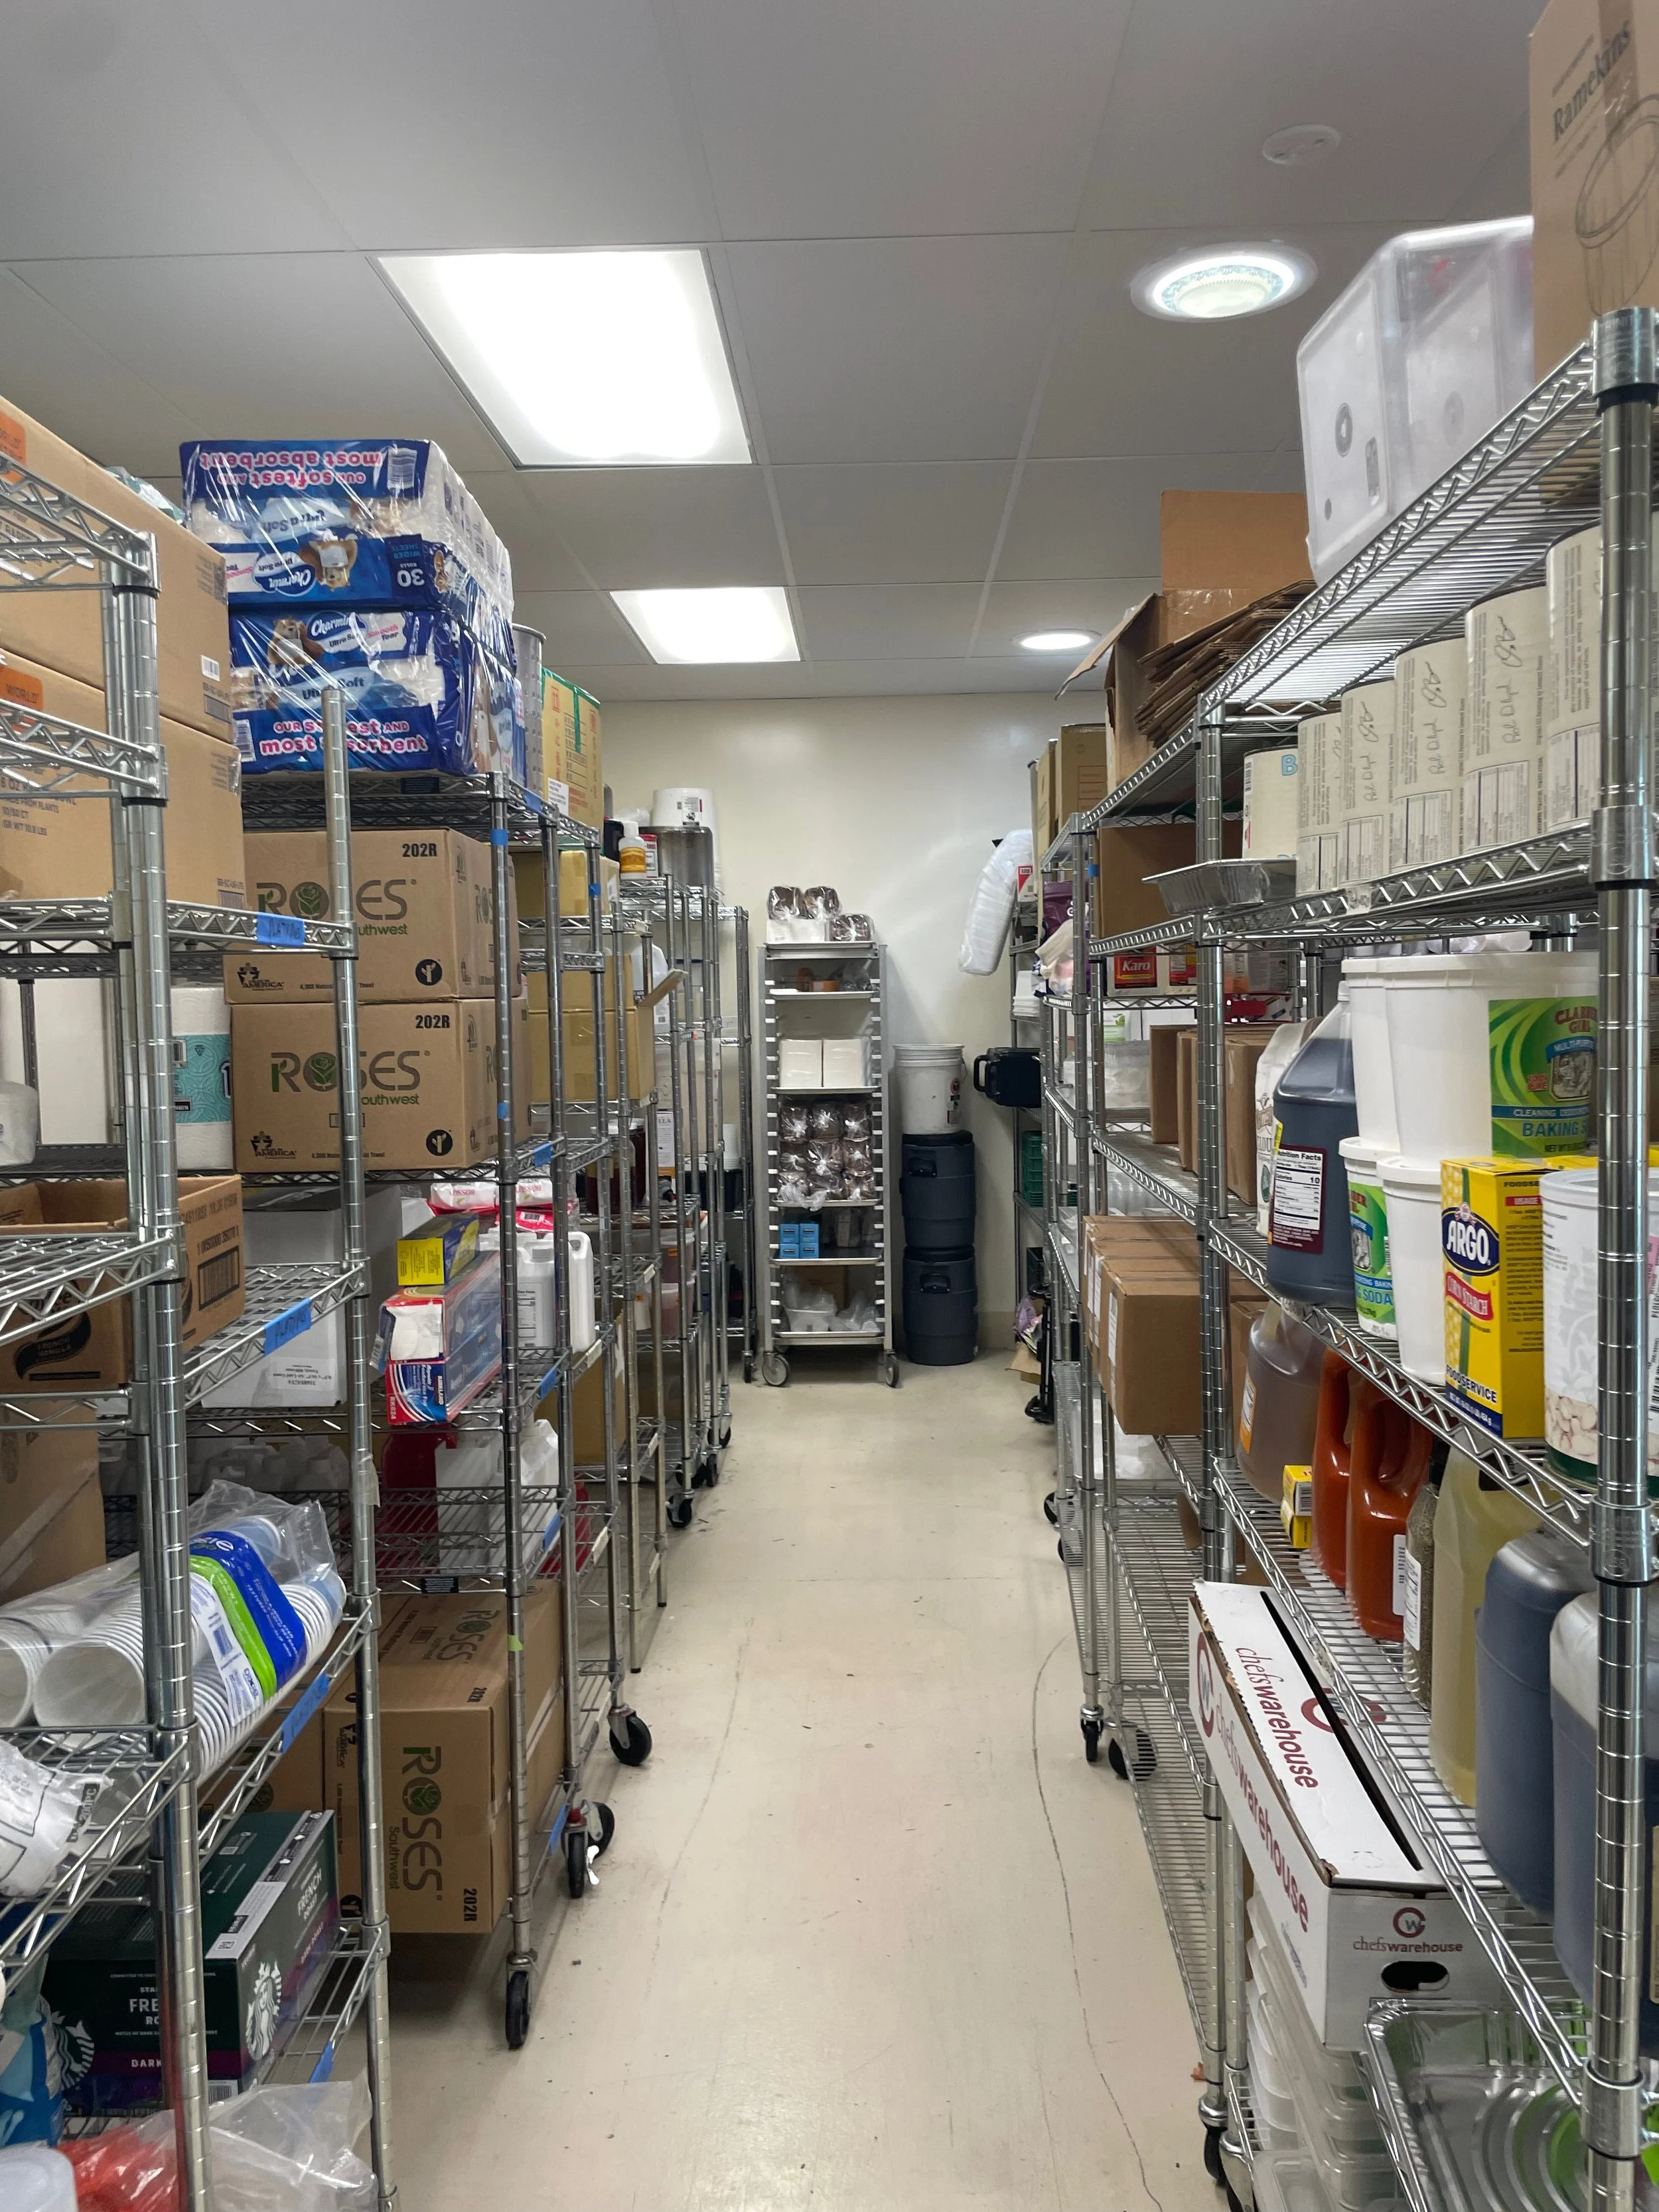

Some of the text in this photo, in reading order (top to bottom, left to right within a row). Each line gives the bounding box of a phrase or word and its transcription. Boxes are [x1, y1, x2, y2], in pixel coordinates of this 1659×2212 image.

[1553, 21, 1631, 143] Ramekins
[201, 451, 382, 469] most absorbent
[251, 471, 337, 488] softest
[267, 567, 312, 588] Charmin
[397, 570, 426, 587] 30
[381, 631, 399, 642] Tear
[274, 721, 301, 733] OUR
[384, 721, 409, 732] AND
[261, 737, 316, 755] most
[402, 842, 438, 858] 202R
[255, 879, 409, 921] ROES
[358, 922, 409, 937] uthwest
[1121, 960, 1151, 972] Karo
[415, 1014, 451, 1030] 202R
[360, 1093, 420, 1106] outhwest
[1513, 1108, 1557, 1117] CLEANING
[1522, 1121, 1579, 1138] BAKING
[1301, 1153, 1322, 1162] Facts
[1447, 1220, 1490, 1266] ARGO
[1374, 1279, 1393, 1290] BAKIN
[1363, 1290, 1394, 1307] SODA
[1447, 1275, 1489, 1315] CORN STARCH
[1446, 1364, 1497, 1404] FOODSERVICE
[467, 1686, 487, 1704] 202R
[1235, 1647, 1319, 1789] chefswarehouse
[401, 1746, 443, 1891] ROSES
[1216, 1693, 1309, 1933] chefswarehouse
[388, 1826, 400, 1890] Southwest
[297, 1867, 323, 1917] FRENCH
[463, 1888, 478, 1922] 202R
[1353, 1936, 1464, 1953] chefswarehouse
[129, 1998, 159, 2013] FRE
